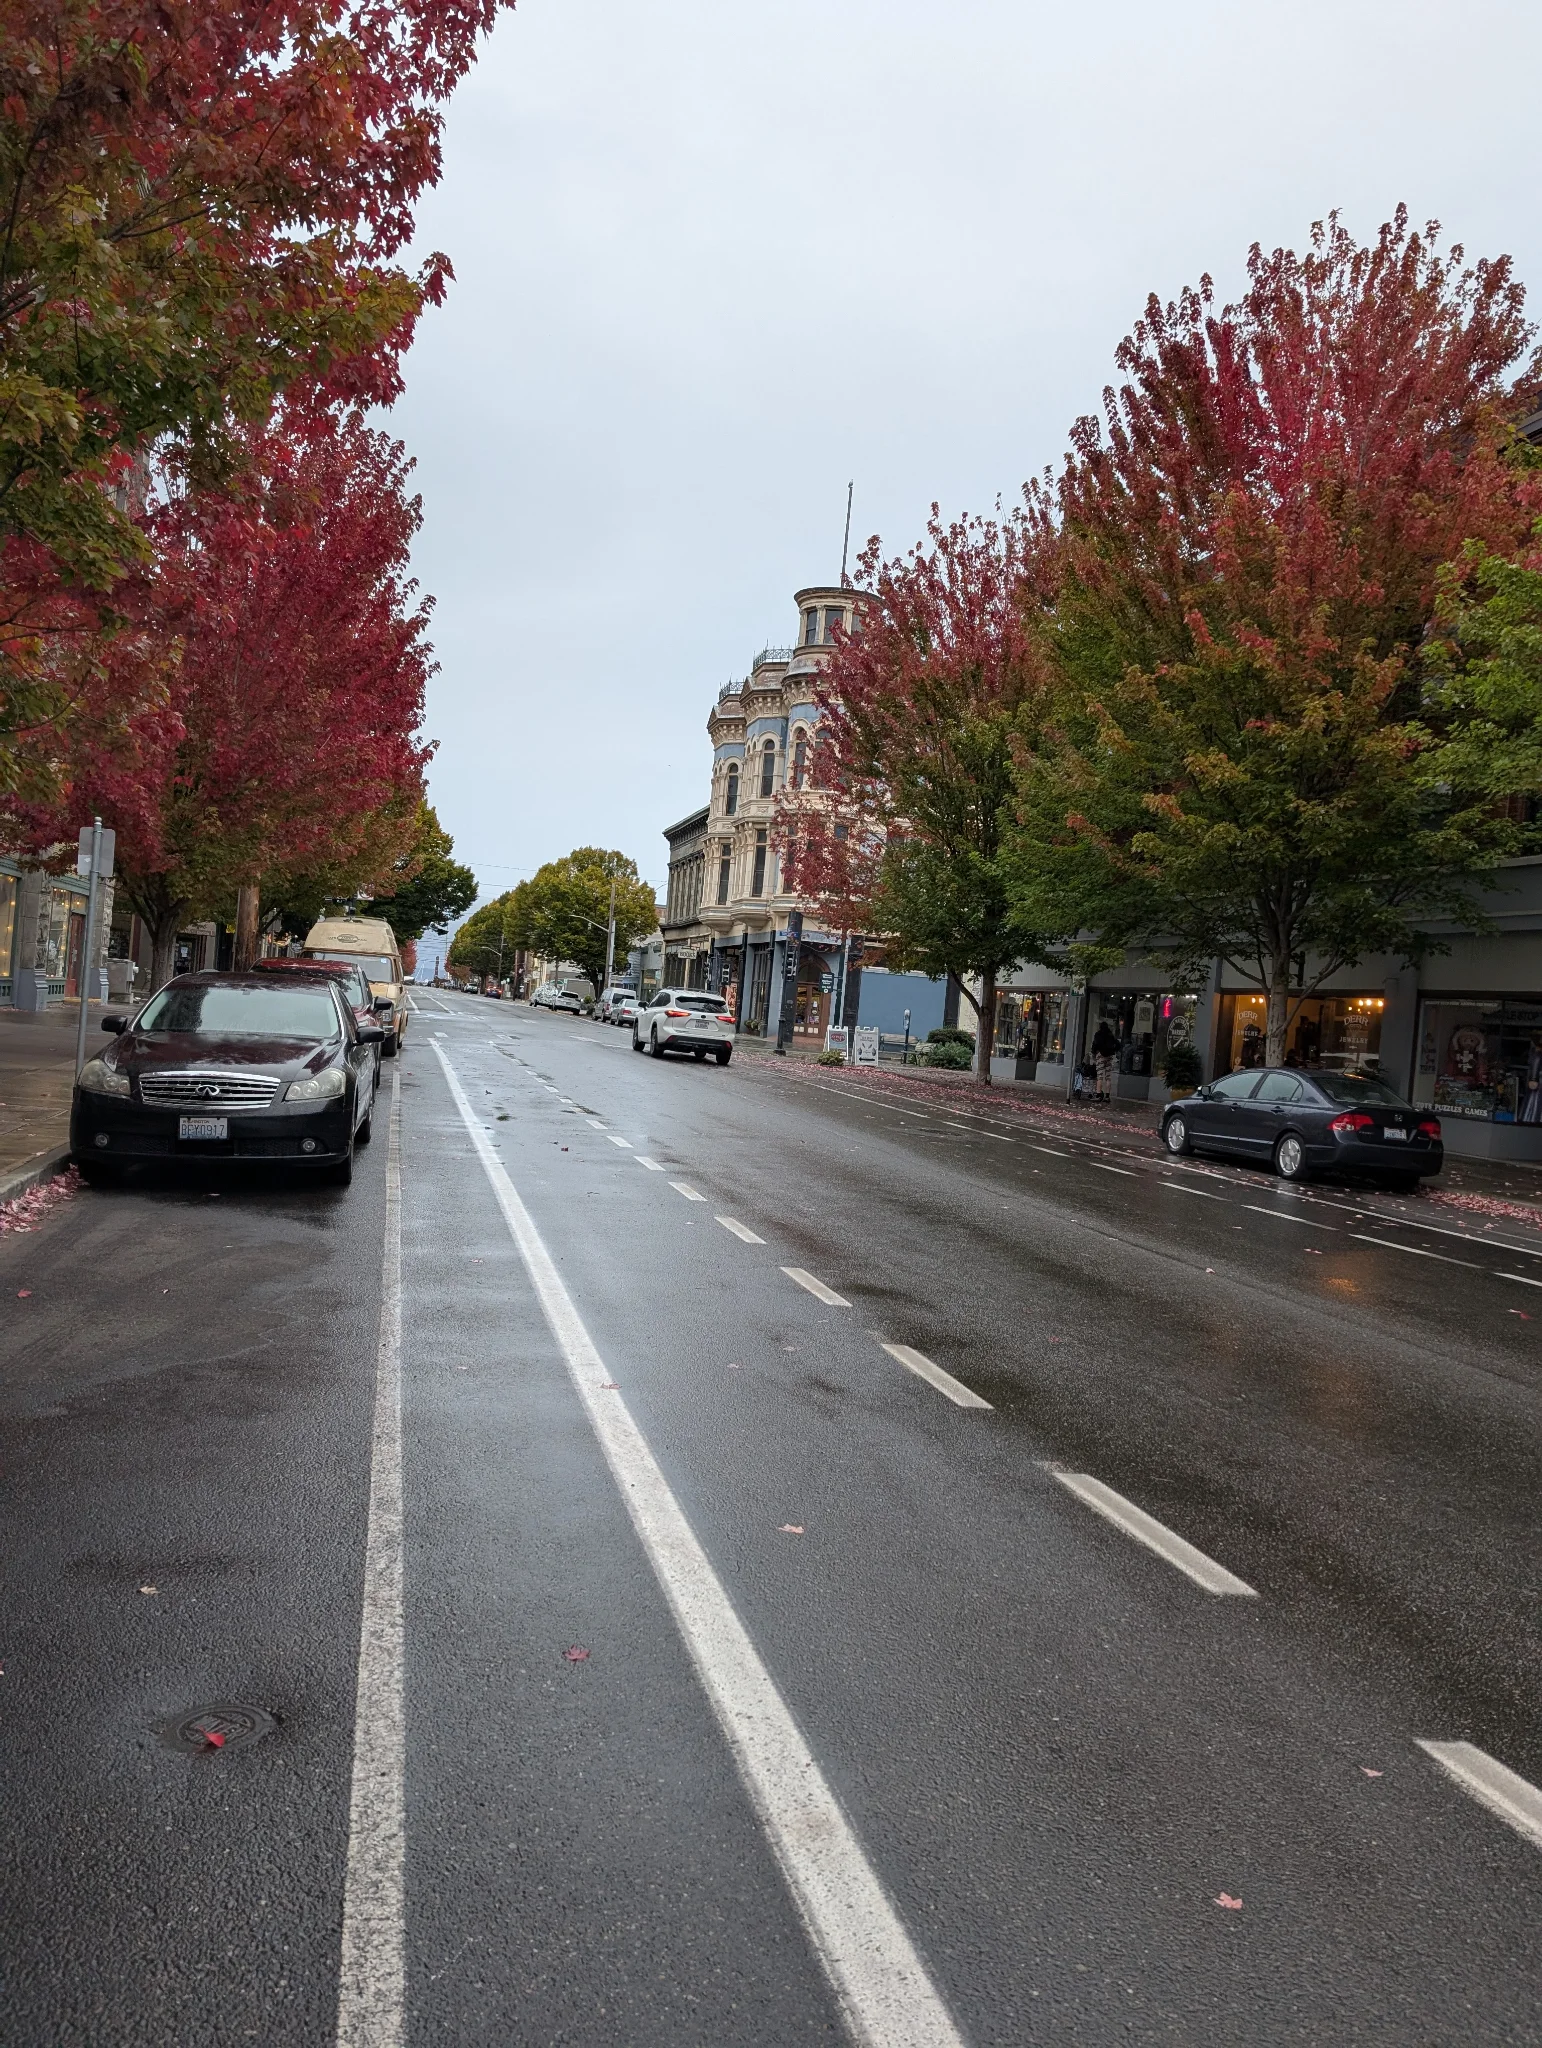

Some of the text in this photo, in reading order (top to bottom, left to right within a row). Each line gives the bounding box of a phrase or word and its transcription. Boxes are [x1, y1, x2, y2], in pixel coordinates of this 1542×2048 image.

[1238, 1011, 1258, 1021] DERR
[1343, 1014, 1369, 1027] DERR
[1339, 1036, 1369, 1044] JEWELRY
[1416, 1101, 1488, 1117] TOYS PUZZLES GAMES
[182, 1124, 224, 1136] BEY0917
